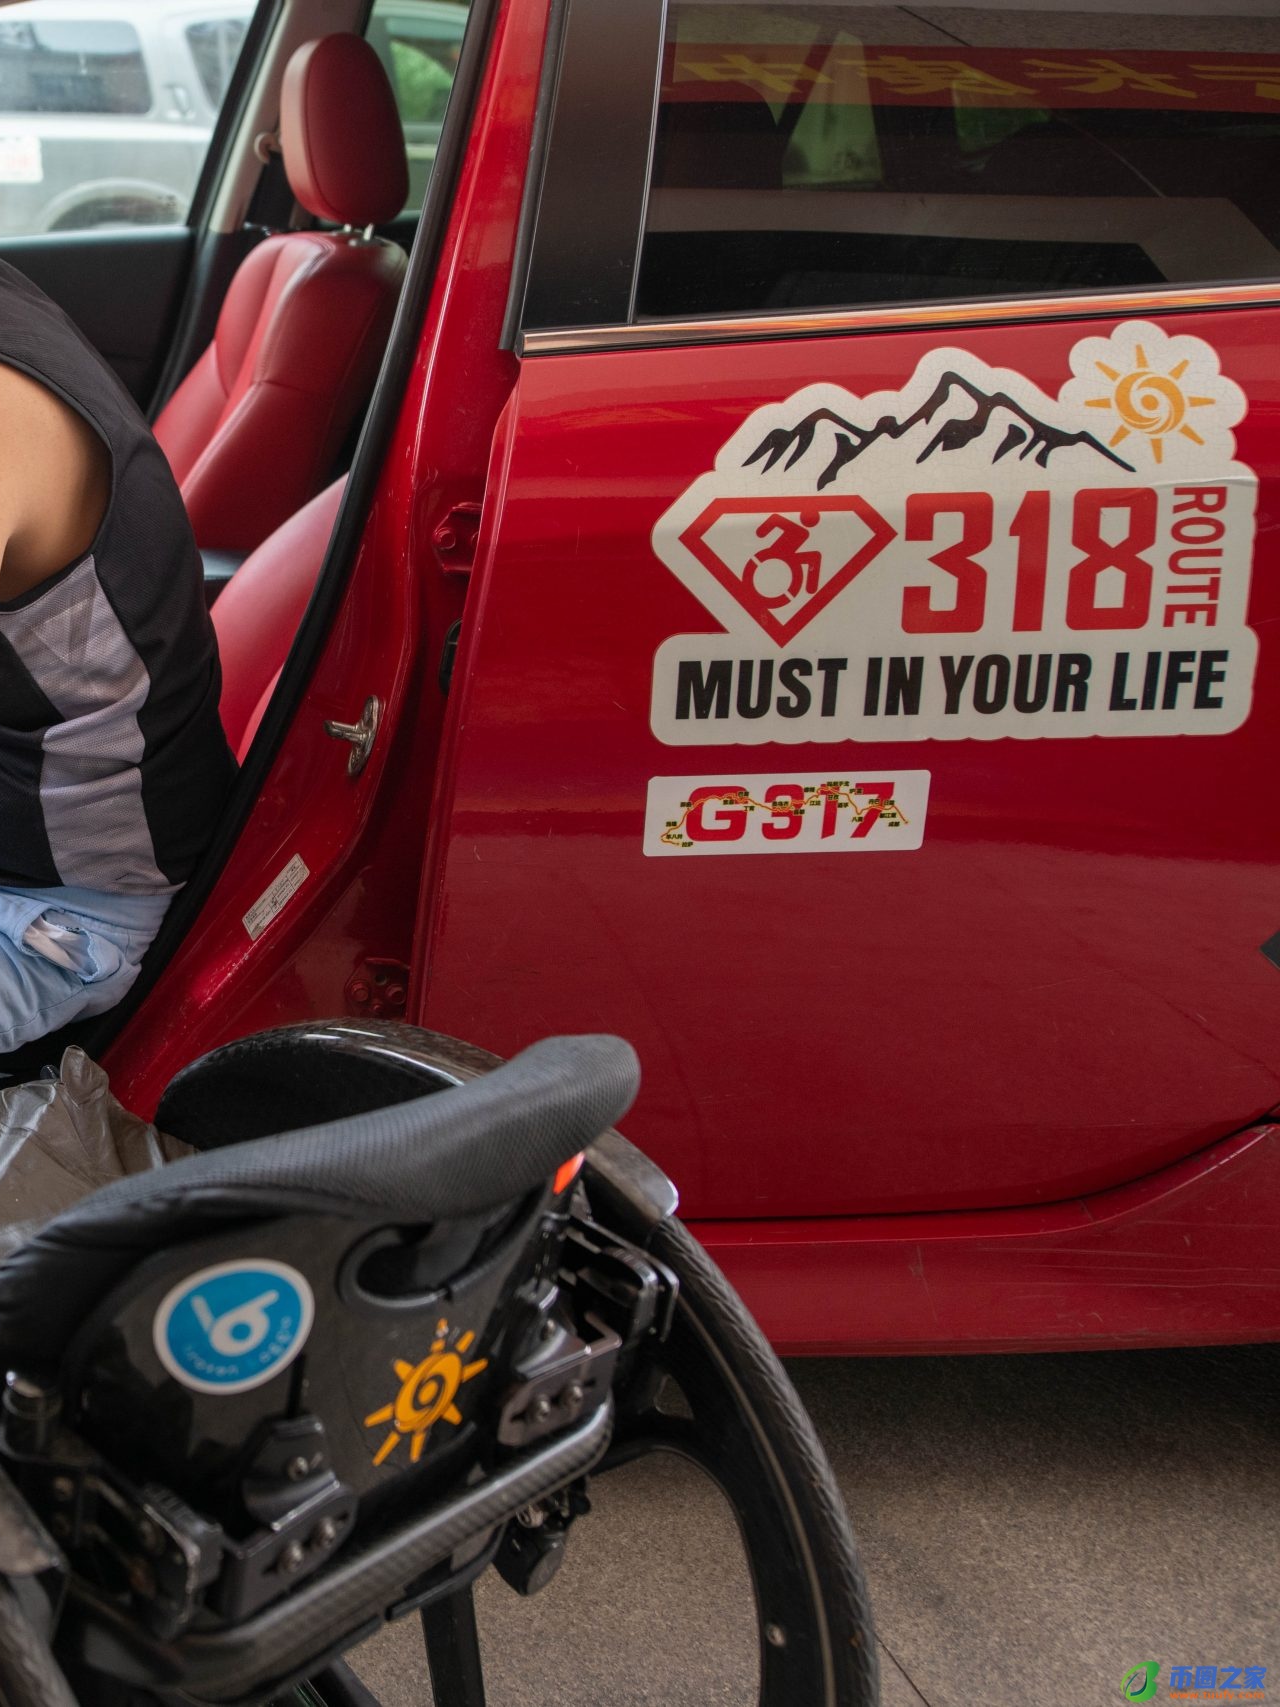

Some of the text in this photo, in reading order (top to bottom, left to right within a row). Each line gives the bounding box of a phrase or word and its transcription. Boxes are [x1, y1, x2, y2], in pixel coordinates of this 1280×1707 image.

[901, 487, 1159, 634] 318
[1163, 486, 1228, 628] ROUTE
[675, 650, 1229, 720] MUST IN YOUR LIFE
[686, 782, 895, 841] G317
